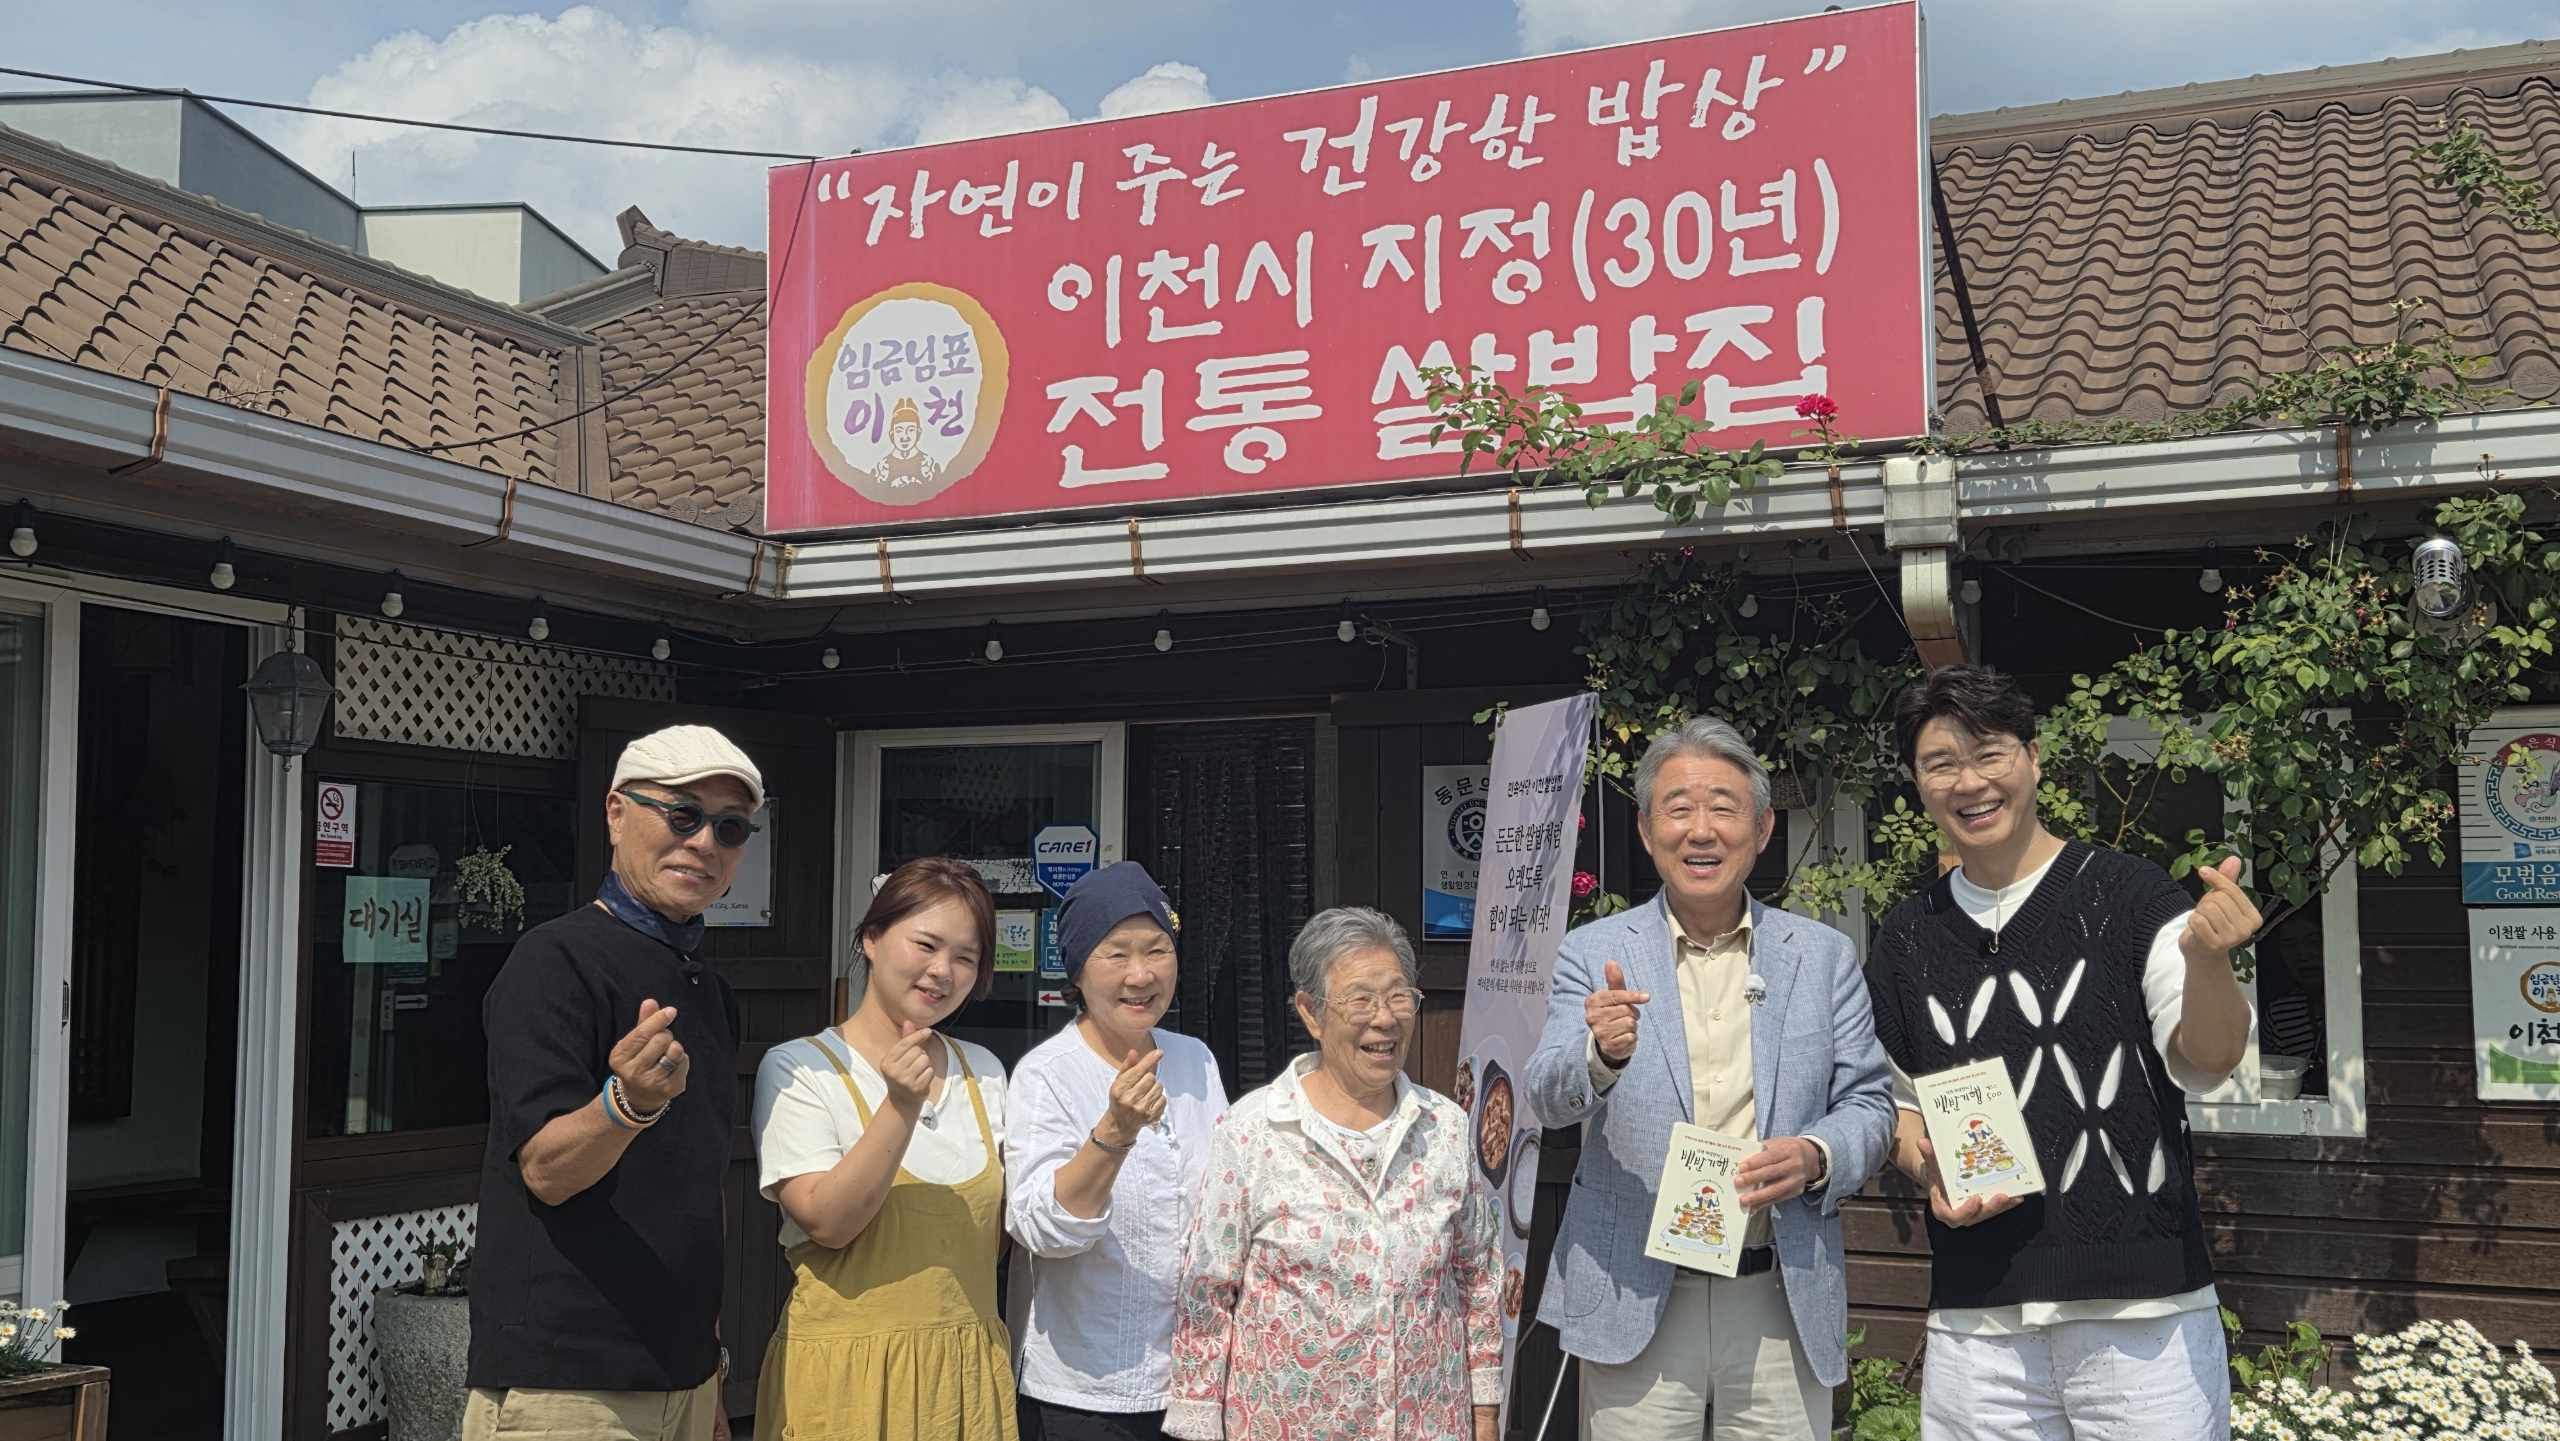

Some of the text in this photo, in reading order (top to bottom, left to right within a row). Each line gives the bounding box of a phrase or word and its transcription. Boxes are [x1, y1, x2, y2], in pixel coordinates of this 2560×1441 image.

[1116, 143, 1245, 226] 주는
[1283, 94, 1556, 195] 건강한
[1047, 158, 1840, 348] 이천시 지정(30년)
[838, 331, 975, 390] 임금님표
[1046, 296, 1829, 489] 전통 쌀밥집
[1507, 774, 1564, 797] 민속식당 이천쌀밥집
[1449, 803, 1468, 830] YONSEI
[1038, 839, 1093, 853] CARE1
[1495, 821, 1563, 853] 든든한 쌀밥처럼
[1505, 864, 1543, 892] 오래도록
[2492, 863, 2560, 886] 모범음
[2495, 887, 2533, 900] Good
[349, 896, 422, 943] 대기실
[1489, 904, 1551, 933] 힘이 되는 시작!
[2489, 925, 2558, 941] 이천쌀 사용
[1490, 958, 1500, 973] 변치
[1500, 958, 1510, 974] 않는
[1477, 976, 1496, 992] 여러분의
[1496, 977, 1509, 993] 새로운
[1509, 978, 1523, 994] 시작을
[2509, 1018, 2560, 1046] 이천
[1933, 1085, 1983, 1114] 백반기행
[1986, 1091, 2002, 1102] 500
[1681, 1149, 1729, 1176] 백반기행
